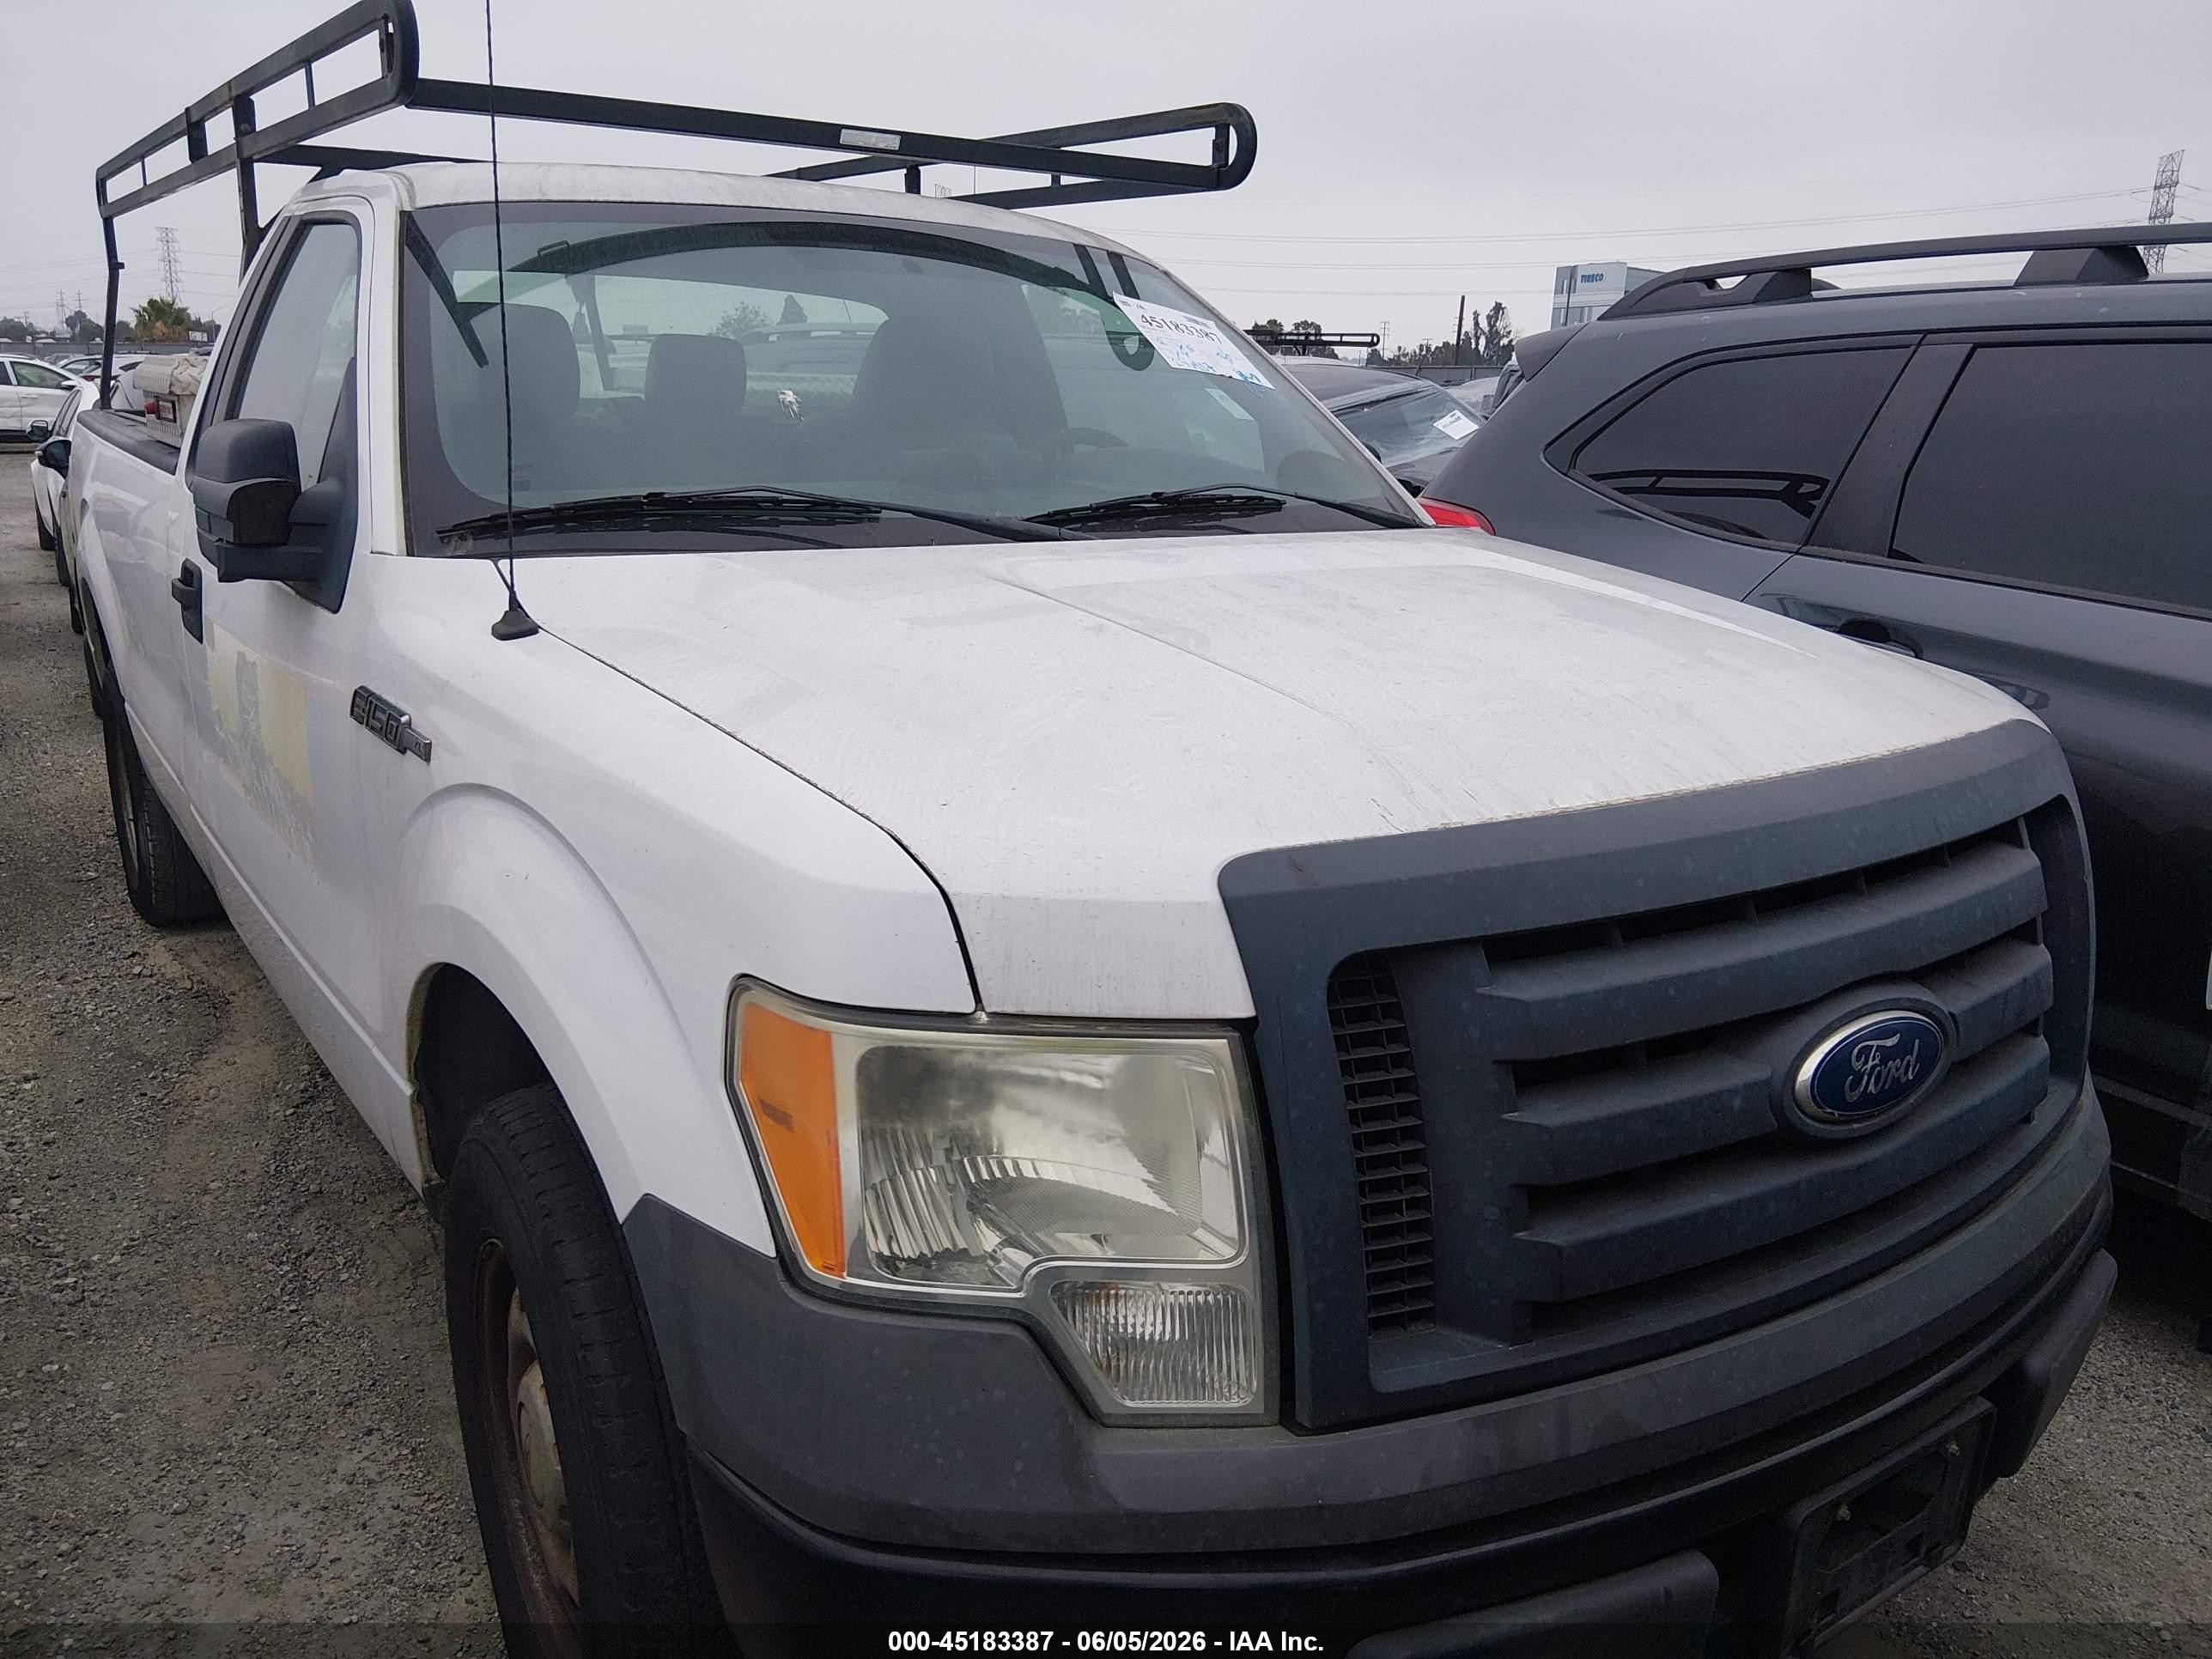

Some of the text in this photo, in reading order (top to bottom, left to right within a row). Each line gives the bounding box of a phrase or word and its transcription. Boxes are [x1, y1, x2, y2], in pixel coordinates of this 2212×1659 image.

[1581, 273, 1604, 283] TIRECO
[1140, 313, 1223, 344] 45183387
[1844, 1033, 1921, 1103] Ford
